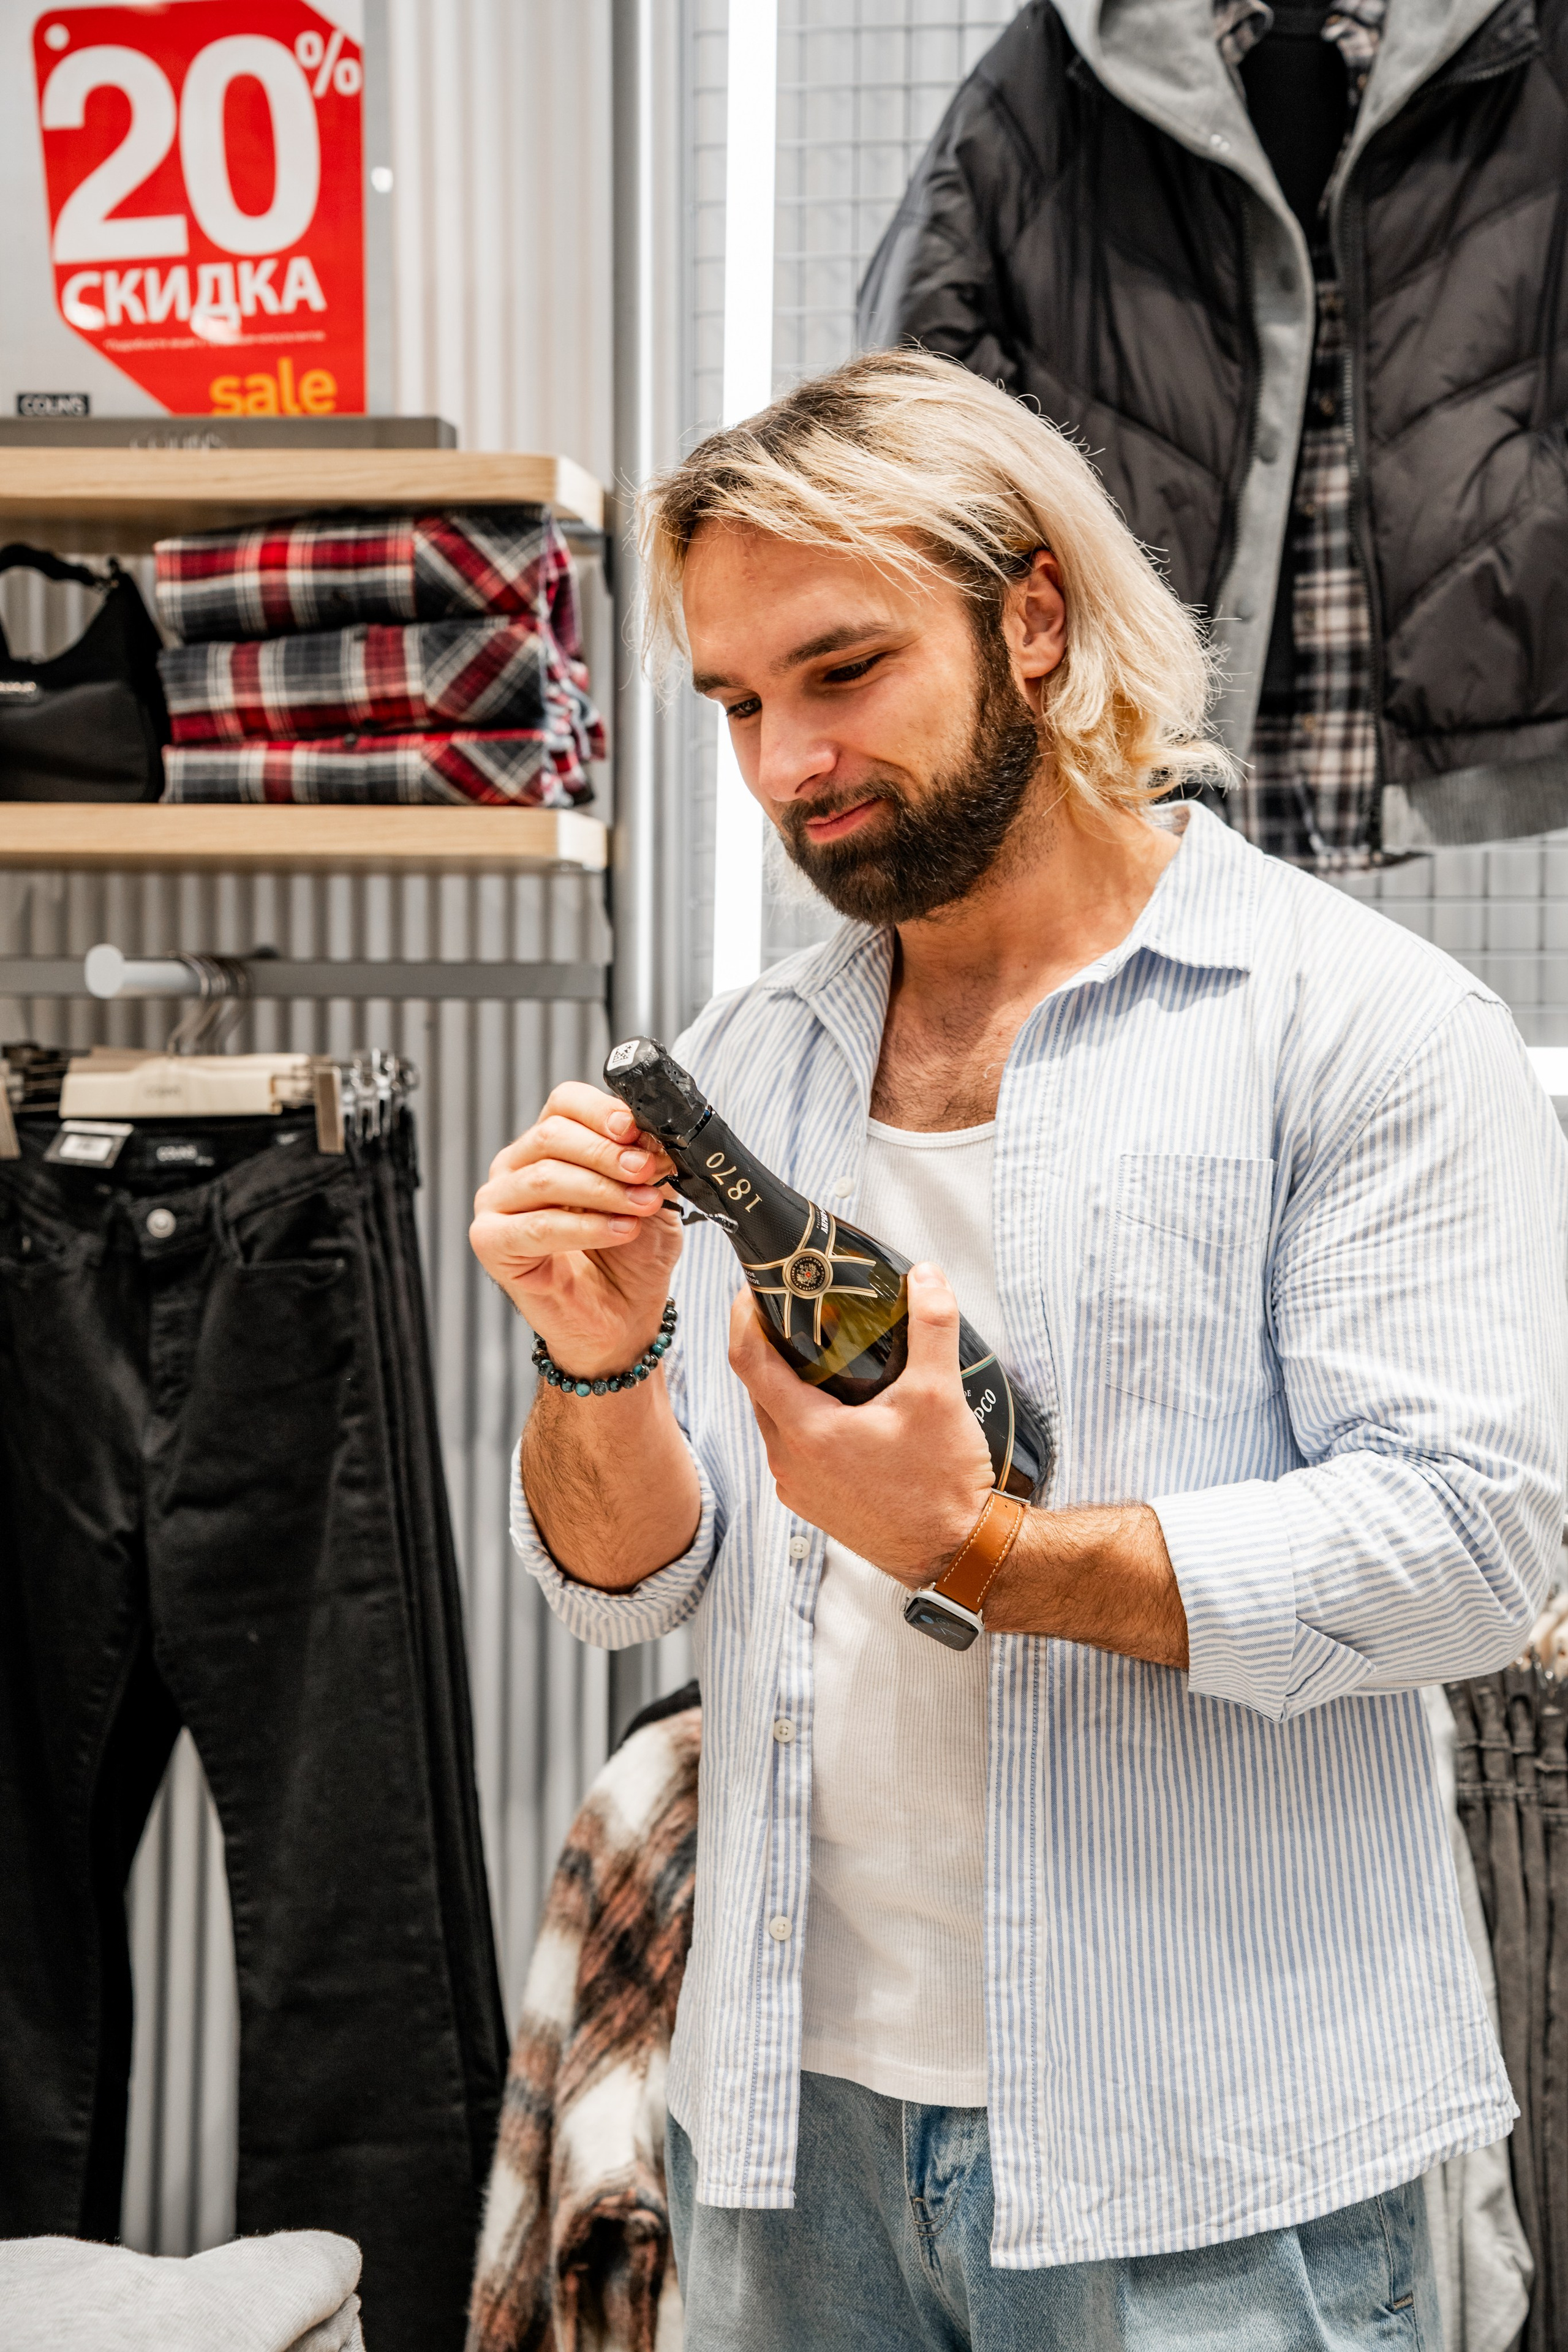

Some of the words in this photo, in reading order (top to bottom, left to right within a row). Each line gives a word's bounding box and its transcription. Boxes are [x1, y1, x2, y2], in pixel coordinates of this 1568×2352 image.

[42, 29, 363, 265] 20%
[62, 255, 328, 330] СКИДКА
[209, 356, 338, 417] sale
[706, 1152, 763, 1213] 1870
[973, 1388, 997, 1424] РСО
